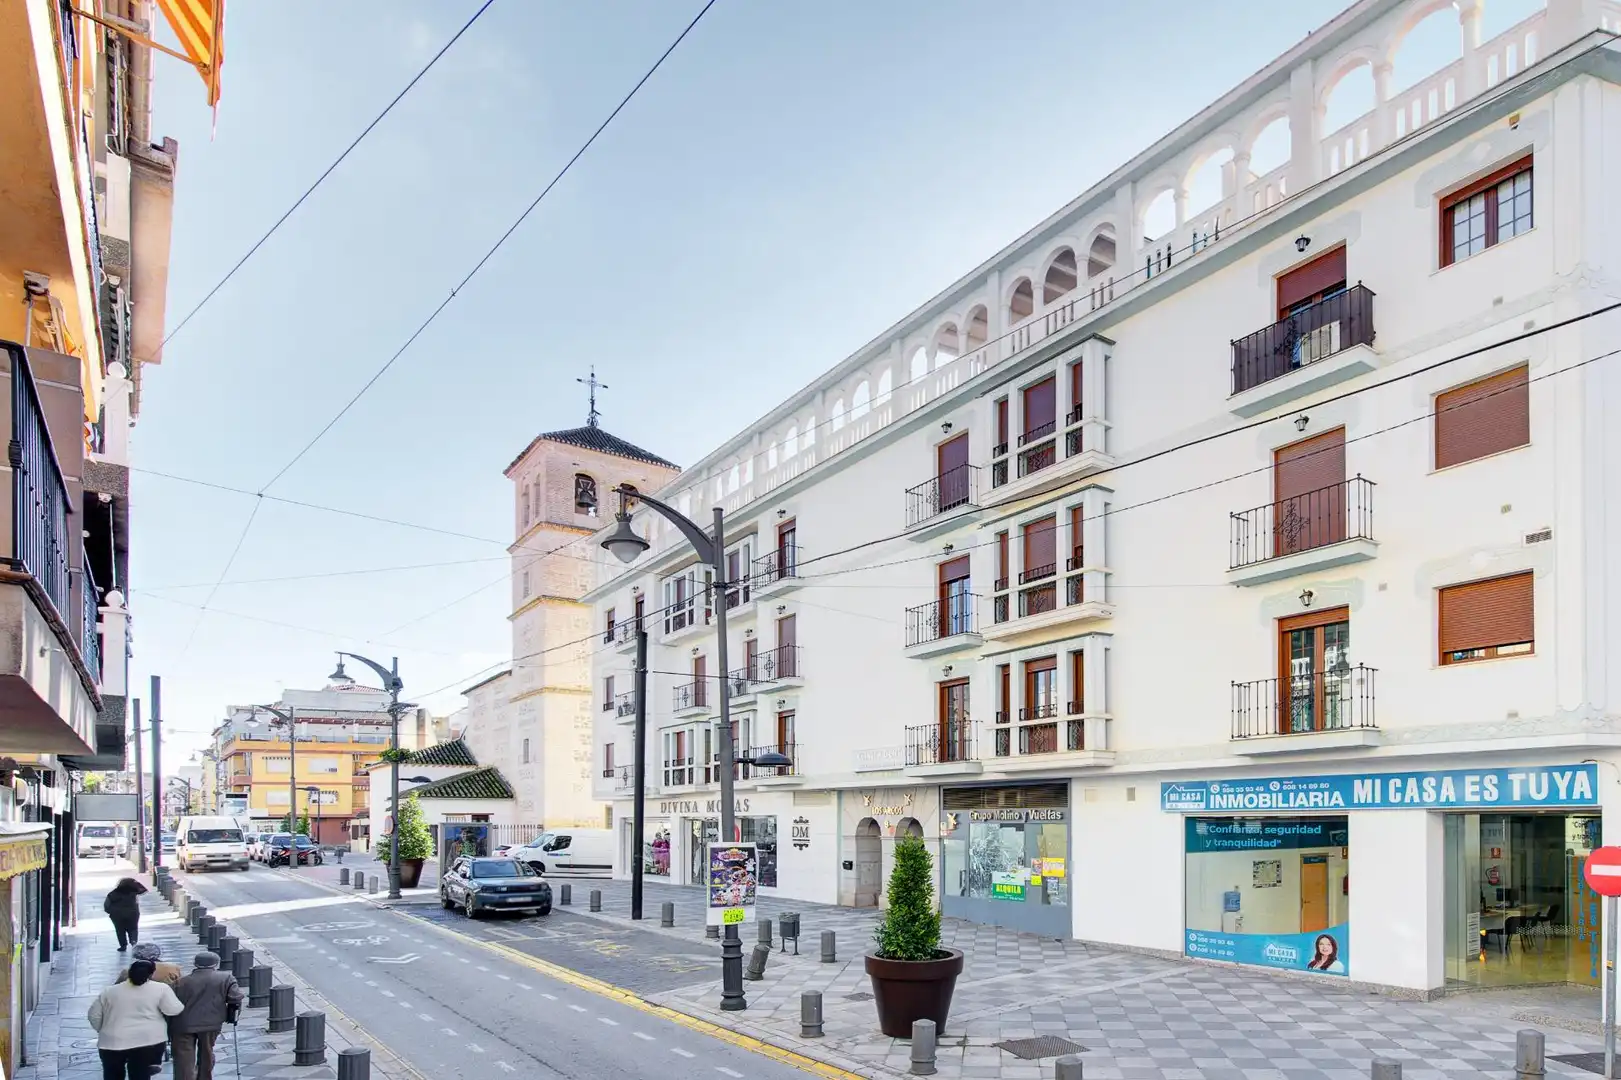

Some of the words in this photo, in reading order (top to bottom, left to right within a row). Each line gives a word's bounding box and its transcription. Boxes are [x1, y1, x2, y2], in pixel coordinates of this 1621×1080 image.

[1353, 779, 1381, 804] MI
[1388, 776, 1457, 804] CASA
[1464, 774, 1499, 802] ES
[1507, 770, 1593, 801] TUYA
[1181, 792, 1201, 801] CASA
[1209, 791, 1345, 808] INMOBILIARIA
[660, 800, 699, 813] DIVINA
[706, 798, 750, 812] MOAS
[872, 806, 884, 815] LOS
[884, 806, 904, 815] ARCOS
[968, 810, 992, 821] Grupo
[993, 810, 1020, 820] Molino
[1021, 813, 1027, 822] y
[1028, 809, 1062, 820] Vueltas
[792, 826, 810, 838] DM
[1264, 825, 1322, 838] seguridad
[1205, 839, 1212, 847] y
[996, 884, 1022, 894] ALQUILA
